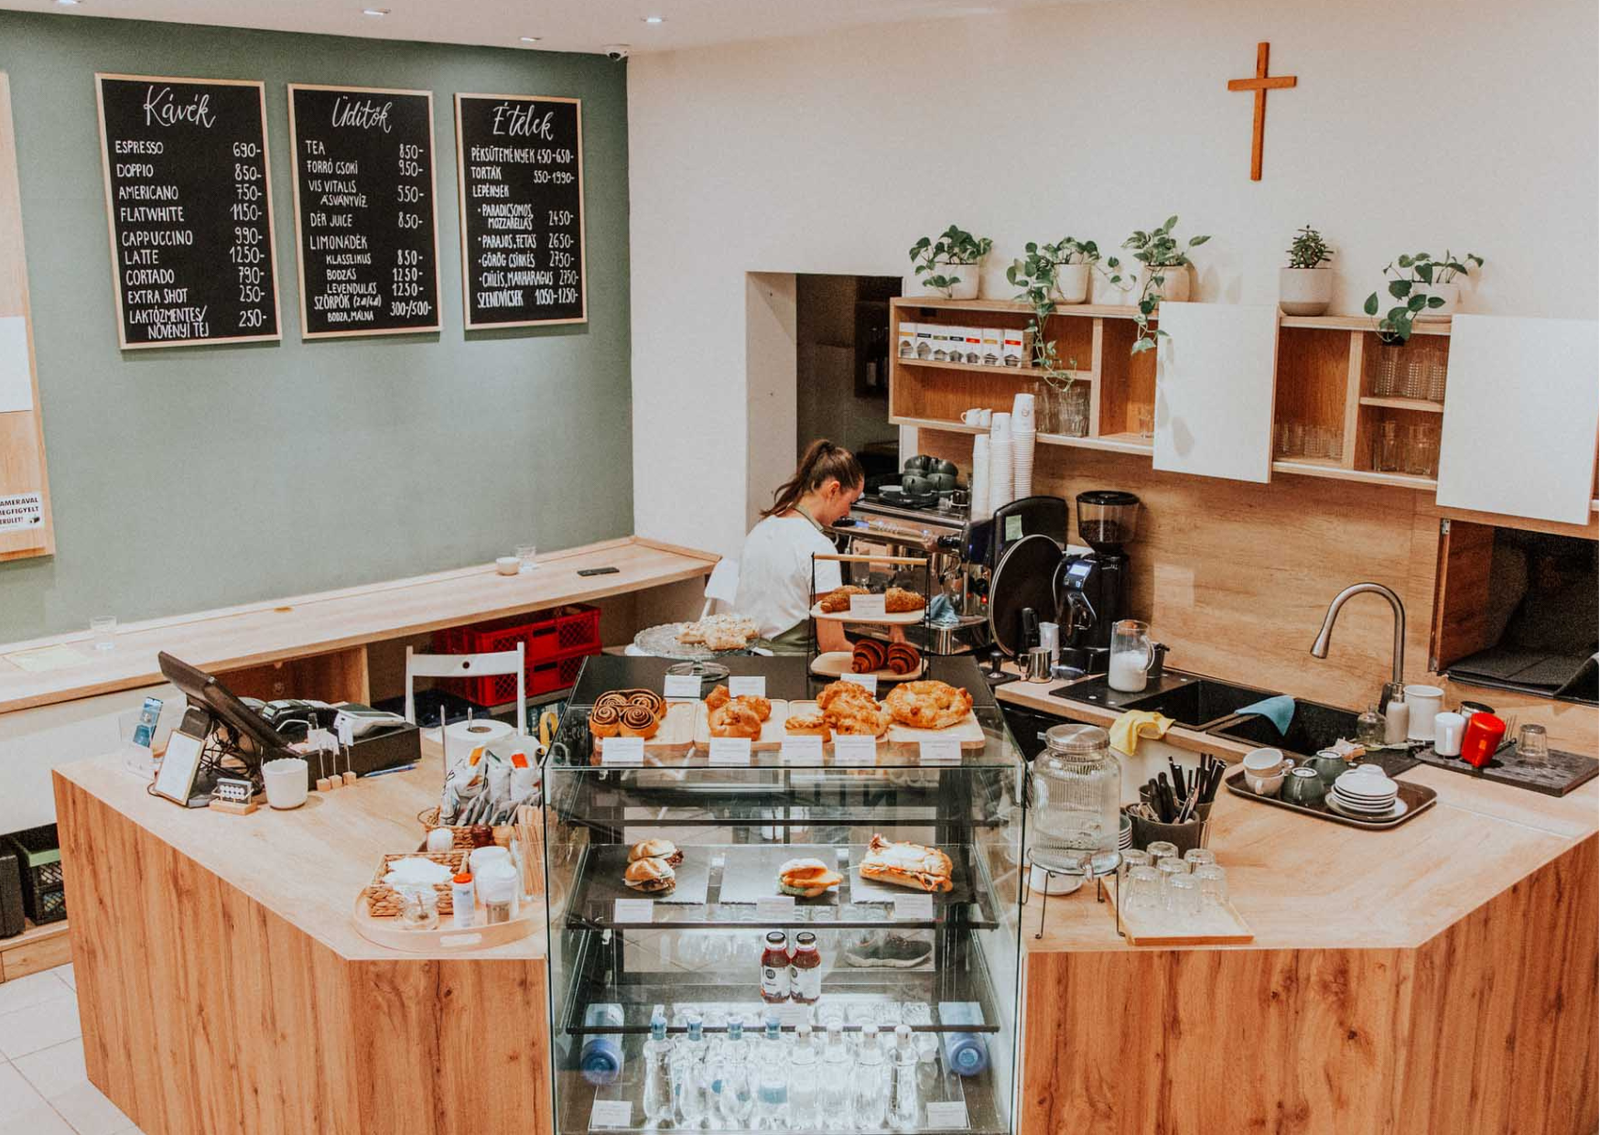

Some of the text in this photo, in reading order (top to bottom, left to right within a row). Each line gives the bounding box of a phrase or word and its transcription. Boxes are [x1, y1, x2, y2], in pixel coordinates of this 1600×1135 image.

[143, 85, 216, 128] Kávék
[492, 101, 554, 141] Ételek
[115, 140, 262, 157] ESPRESSO 690-
[305, 140, 424, 159] TEA 850-
[117, 163, 262, 181] DOPPIO 850-
[307, 158, 424, 177] FORRÓ CSOKI 950-
[471, 165, 502, 180] TORTÁK
[119, 184, 263, 201] AMERICANO 750-
[308, 180, 357, 193] VIS VITALIS
[397, 185, 425, 203] 550-
[121, 203, 262, 222] FLATWHITE 1150-
[330, 213, 353, 227] JUICE
[398, 211, 424, 229] 850-
[548, 210, 574, 226] 2450-
[122, 227, 263, 246] CAPPUCCINO 990-
[548, 233, 574, 249] 2650-
[125, 247, 265, 265] LATTE 1250-
[397, 249, 424, 265] 850-
[481, 252, 507, 267] GÖRÖG
[549, 251, 575, 267] 2750-
[126, 266, 265, 285] CORTADO 790-
[392, 267, 424, 282] 1250-
[128, 285, 265, 304] EXTRA SHOT 250-
[392, 283, 424, 297] 1250-
[238, 309, 267, 327] 250-
[192, 322, 209, 337] TEJ
